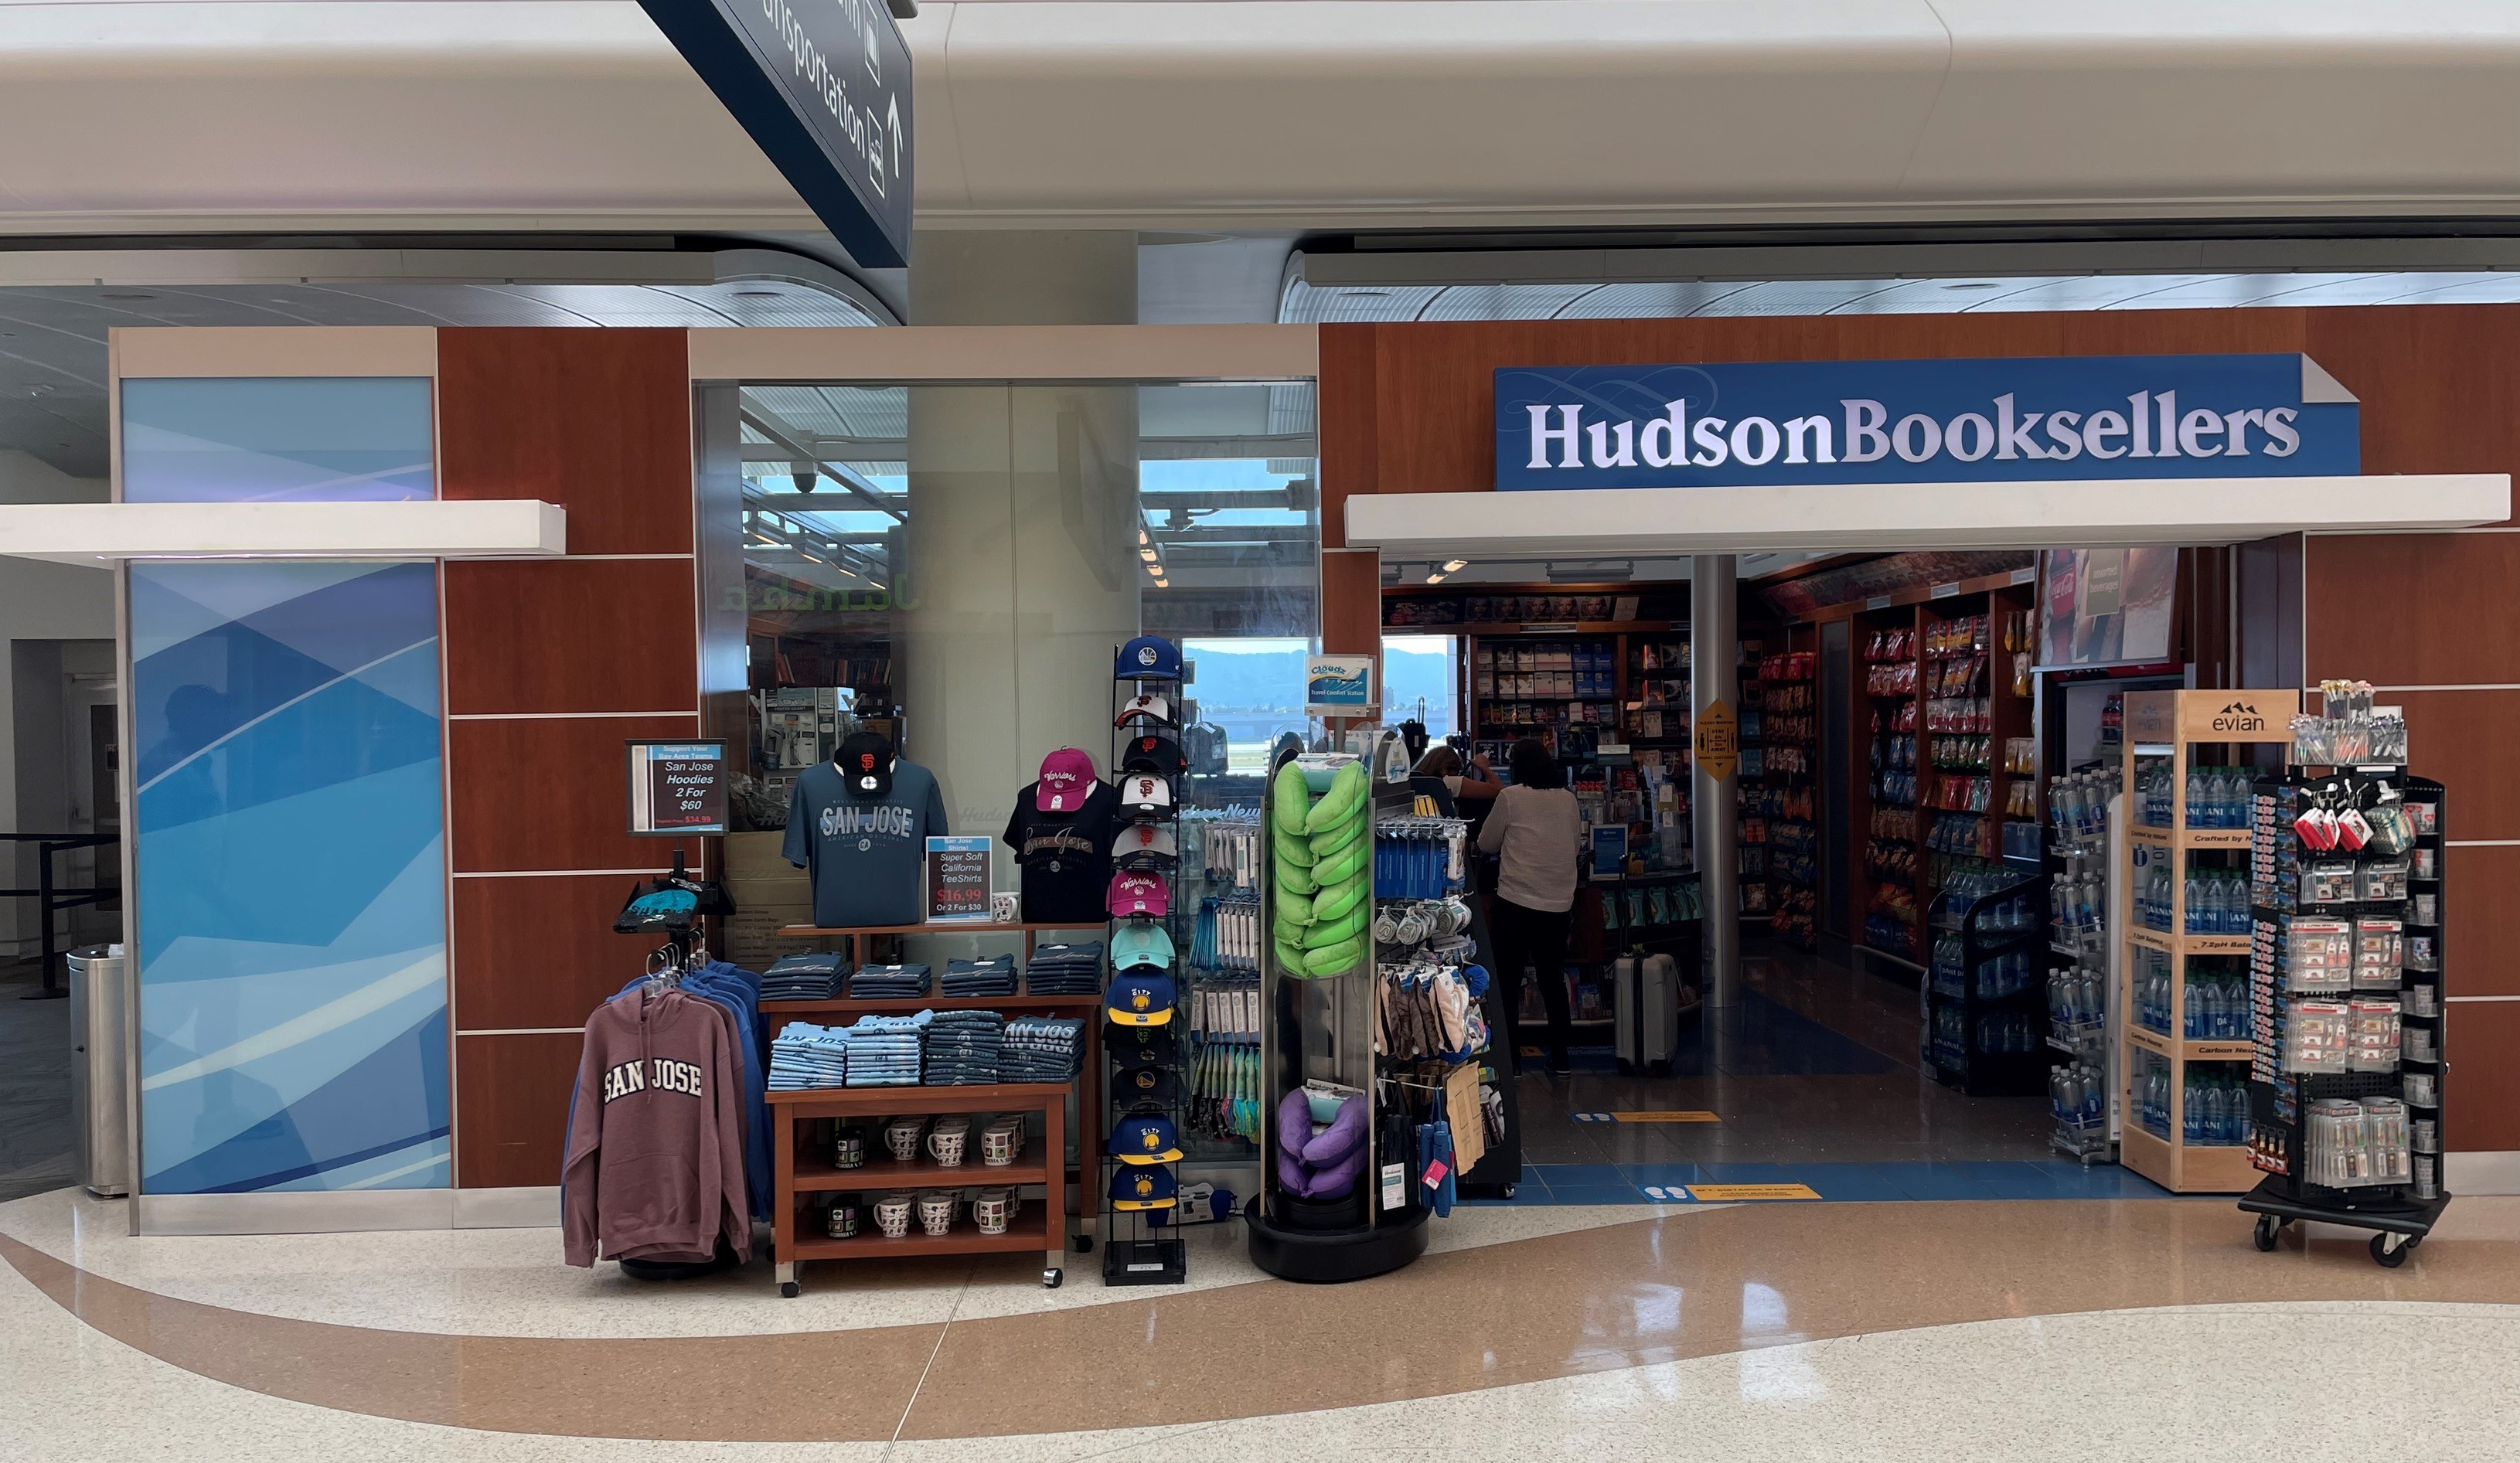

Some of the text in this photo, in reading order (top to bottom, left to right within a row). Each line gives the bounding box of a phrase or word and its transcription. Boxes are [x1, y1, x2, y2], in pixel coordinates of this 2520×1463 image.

[757, 0, 865, 159] ansportation
[2093, 565, 2117, 579] assorted
[2089, 581, 2119, 593] beverages
[2212, 715, 2265, 731] evian
[665, 761, 714, 771] San Jose
[666, 774, 714, 784] Hoodies
[676, 788, 706, 797] 2 For
[680, 800, 702, 811] $60
[1224, 804, 1261, 819] New
[822, 807, 860, 835] SAN
[864, 805, 912, 838] JOSE
[860, 840, 869, 849] CA
[1026, 826, 1090, 855] San Jose
[940, 852, 983, 862] Super Soft
[941, 863, 982, 872] California
[942, 874, 982, 883] TeeShirts
[1121, 877, 1156, 890] Warriors
[937, 889, 982, 902] $16.99
[1004, 1023, 1077, 1038] AN JOS
[604, 1057, 702, 1104] SAN JOSE
